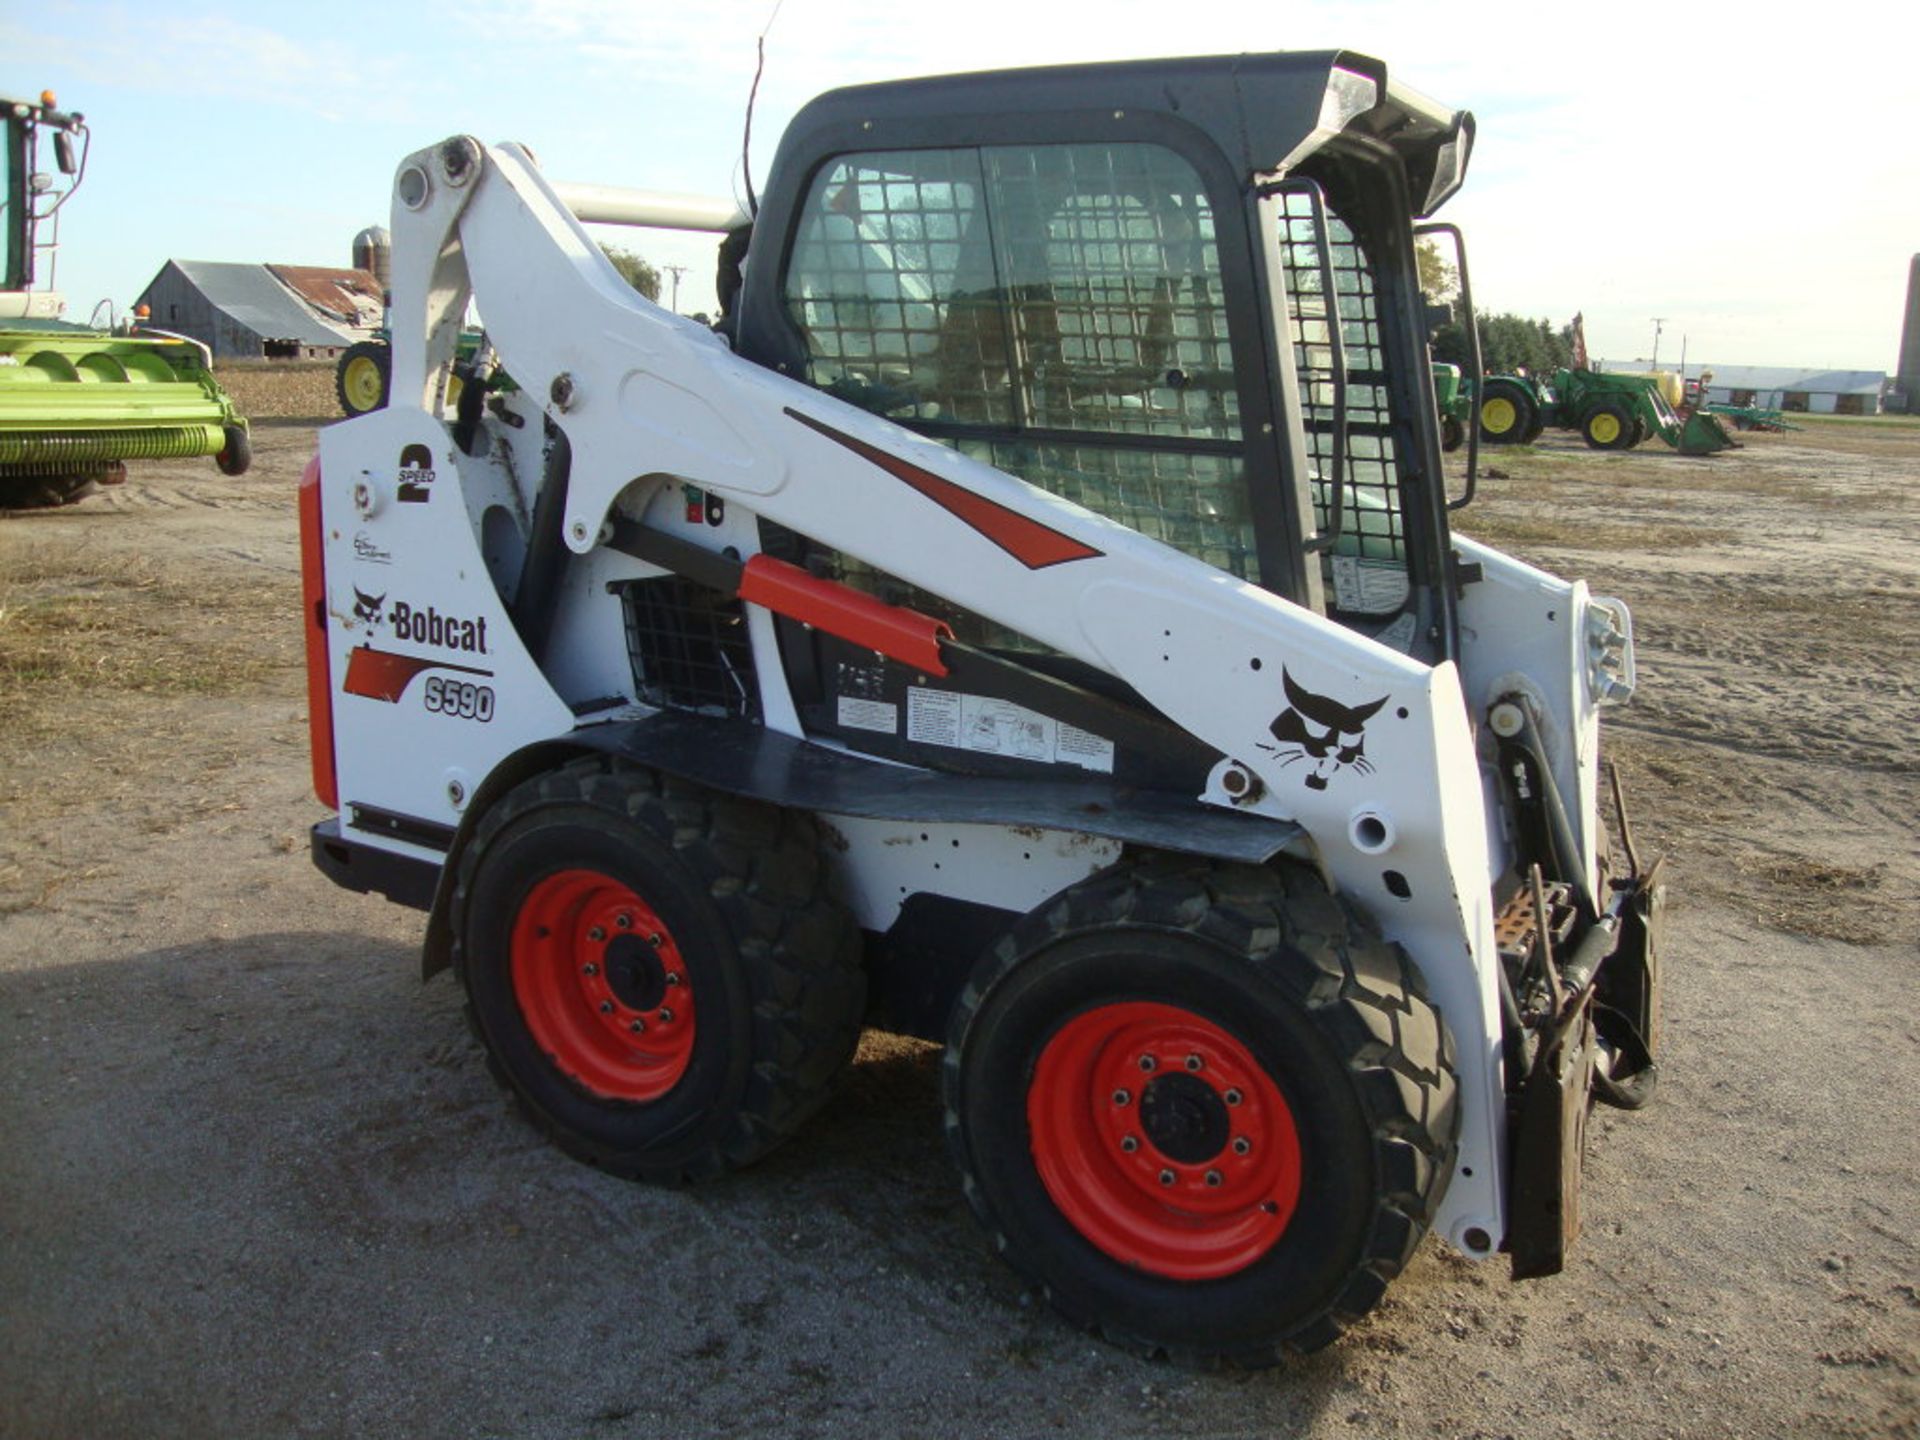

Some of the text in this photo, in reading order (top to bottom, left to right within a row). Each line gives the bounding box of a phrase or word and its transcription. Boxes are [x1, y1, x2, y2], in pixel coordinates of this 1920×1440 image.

[397, 443, 432, 503] 2
[398, 470, 436, 483] SPEED
[394, 601, 487, 655] Bobcat
[424, 676, 495, 723] S590
